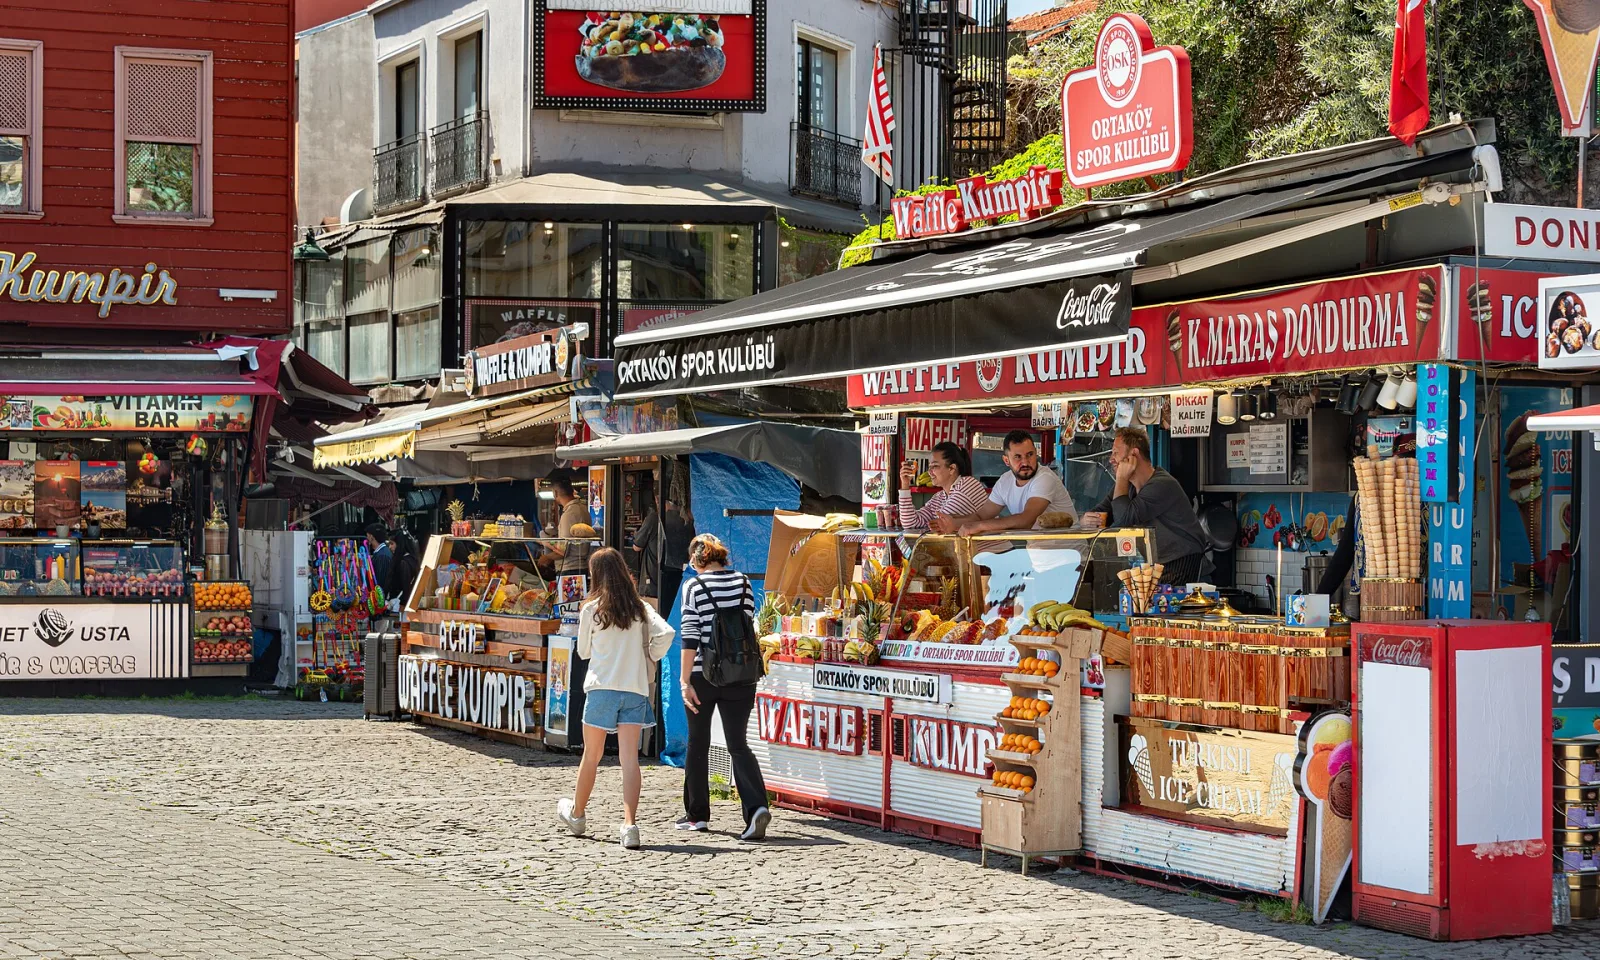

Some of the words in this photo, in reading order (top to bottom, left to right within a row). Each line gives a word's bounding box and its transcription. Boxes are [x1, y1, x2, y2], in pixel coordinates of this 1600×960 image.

[1107, 51, 1129, 72] OSK
[1091, 103, 1153, 141] ORTAKÖY
[1076, 144, 1111, 171] SPOR
[1114, 125, 1170, 163] KULÜBÜ
[891, 193, 960, 237] Waffle
[957, 168, 1051, 220] Kumpir
[1514, 216, 1600, 250] DON
[0, 251, 178, 318] Kumpir
[500, 307, 567, 324] WAFFLE
[1056, 281, 1122, 330] Coca-Cola
[1500, 294, 1538, 339] IC
[1187, 309, 1279, 369] K.MARAŞ
[1281, 291, 1410, 359] DONDURMA
[475, 351, 508, 387] WAFFLE
[507, 349, 516, 381] &
[617, 349, 678, 385] ORTAKÖY
[681, 350, 714, 379] SPOR
[717, 335, 776, 374] KULÜBÜ
[862, 360, 961, 396] WAFFLE
[874, 412, 893, 421] KALİTE
[1175, 394, 1209, 407] DİKKAT
[1178, 410, 1206, 420] KALİTE
[135, 411, 180, 429] BAR
[870, 425, 897, 434] BAĞIRMAZ
[1172, 424, 1210, 435] BAĞIRMAZ
[1425, 367, 1438, 498] DONDURMA
[80, 626, 131, 642] USTA
[1372, 637, 1425, 666] Coca-Cola
[27, 656, 44, 675] &
[49, 655, 136, 675] WAFFLE
[921, 645, 955, 661] ORTAKÖY
[953, 648, 975, 662] SPOR
[973, 647, 1006, 663] KULÜBÜ
[397, 654, 454, 719] WAFFLE
[457, 665, 527, 735] KUMPIR
[816, 670, 862, 690] ORTAKÖY
[862, 674, 890, 693] SPOR
[892, 677, 936, 698] KULÜBÜ
[756, 696, 857, 753] WAFFLE
[909, 718, 1005, 776] KUMP
[1168, 736, 1252, 775] TURKISH
[1159, 775, 1190, 805] ICE
[1196, 781, 1262, 817] CREAM
